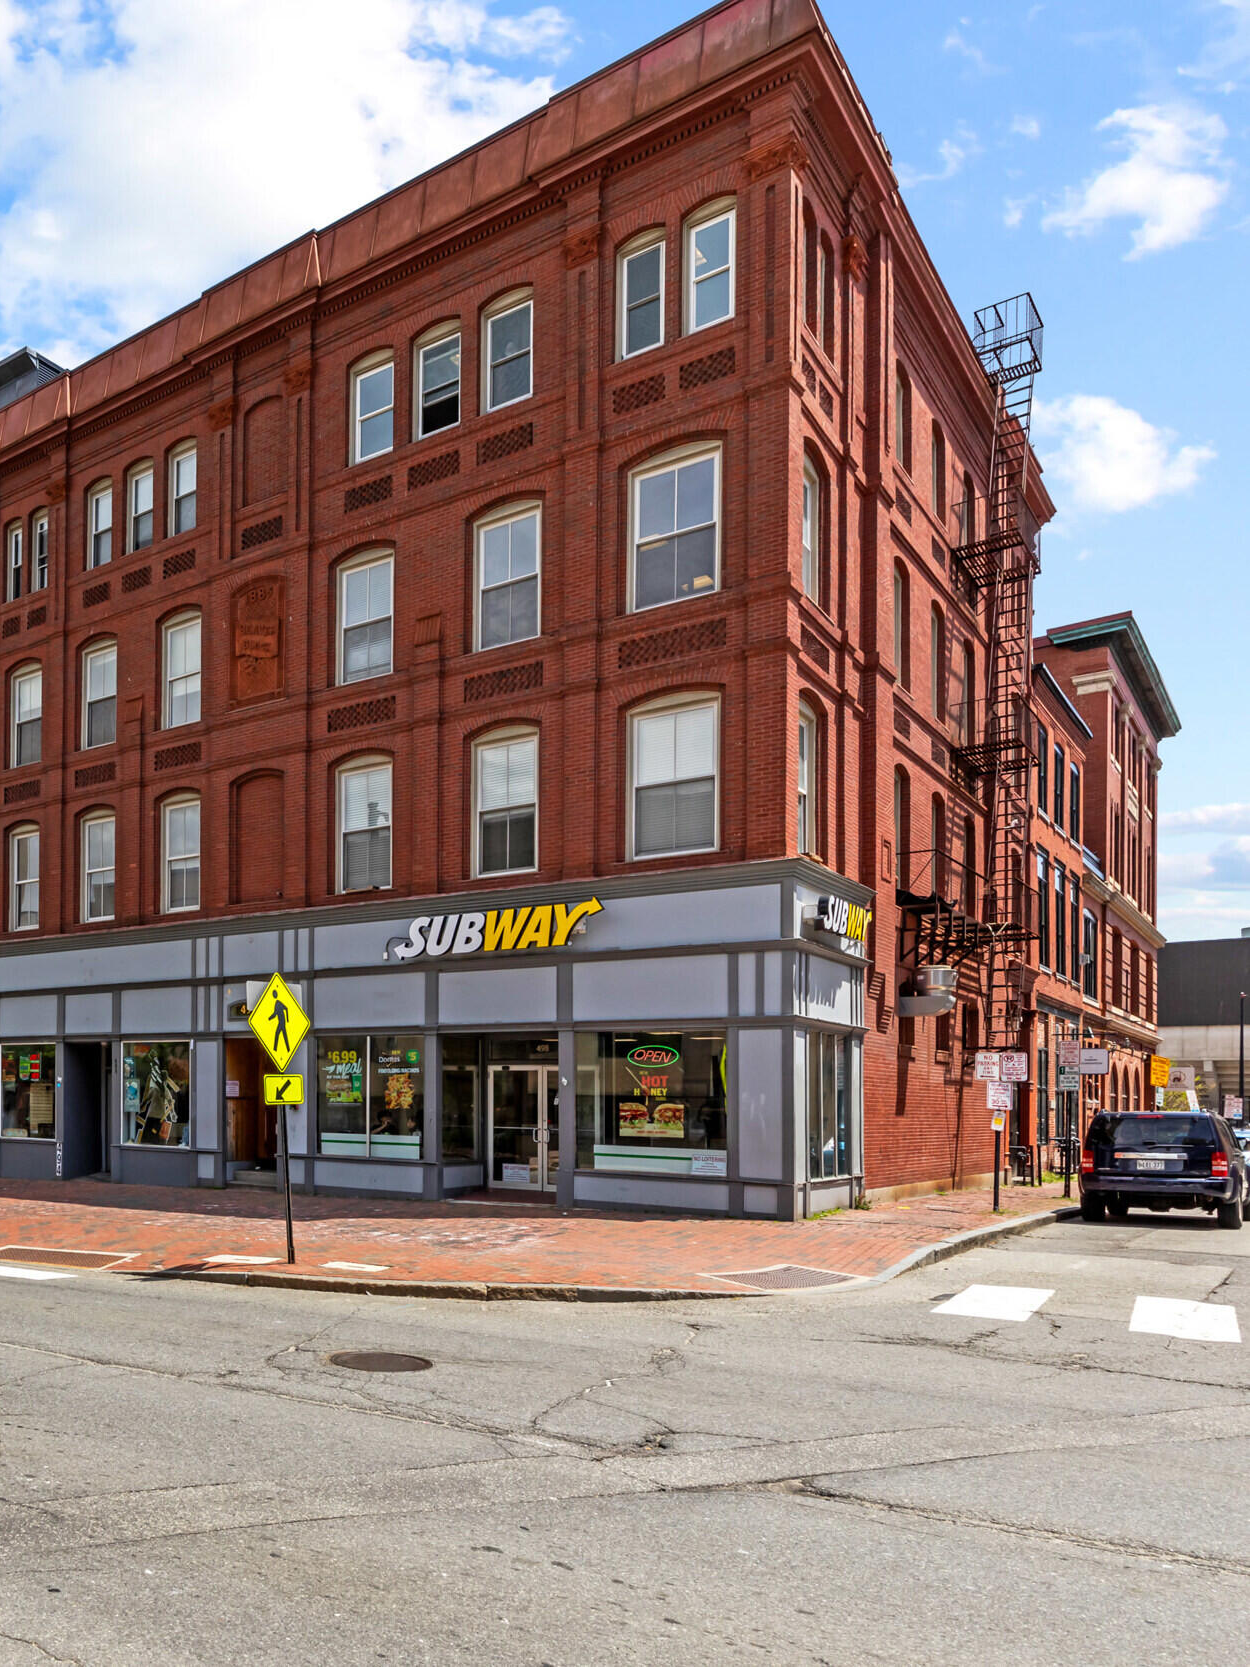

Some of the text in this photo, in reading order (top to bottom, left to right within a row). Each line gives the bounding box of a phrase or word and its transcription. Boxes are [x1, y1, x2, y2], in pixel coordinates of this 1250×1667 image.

[823, 894, 873, 942] SUBWAY
[394, 896, 605, 961] SUBWAY
[327, 1050, 357, 1064] $6.99
[633, 1049, 672, 1063] OPEN
[336, 1057, 362, 1075] meal
[641, 1075, 669, 1088] HOT
